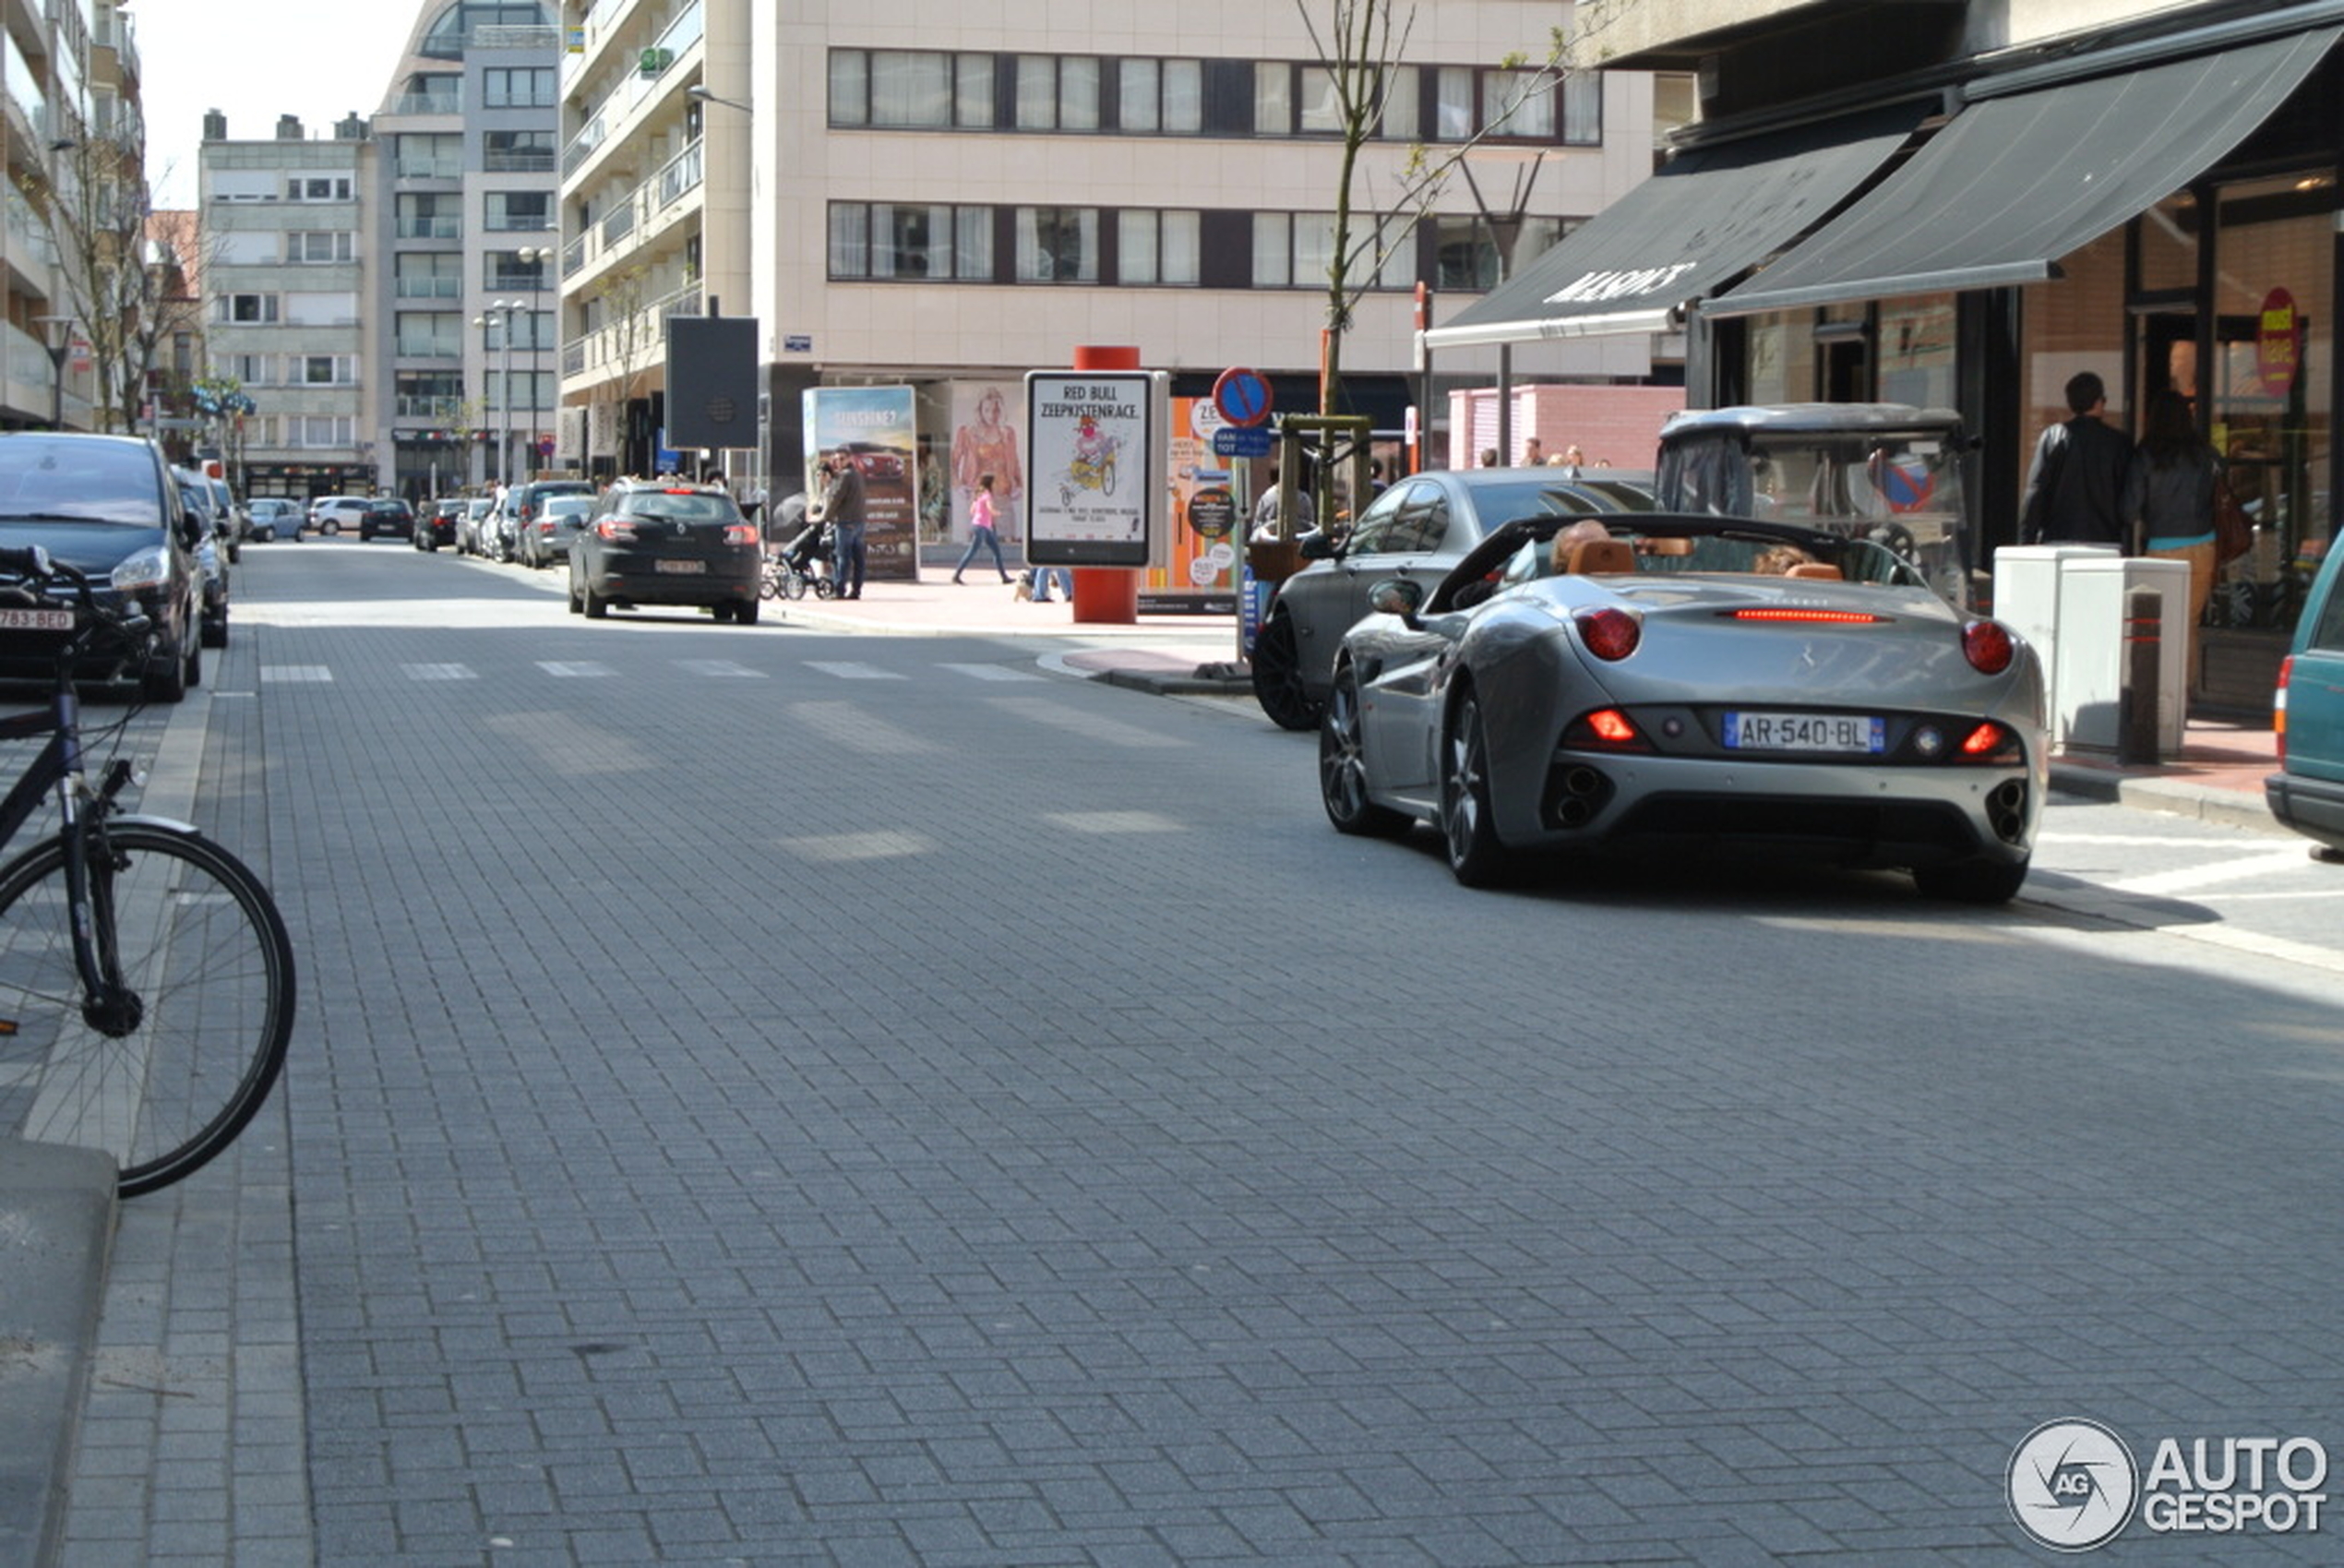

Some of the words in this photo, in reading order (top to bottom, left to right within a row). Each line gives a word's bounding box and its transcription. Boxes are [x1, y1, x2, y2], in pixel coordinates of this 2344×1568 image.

[1063, 386, 1086, 400] RED
[1090, 386, 1118, 401] BULL
[1217, 444, 1237, 453] TOT
[1740, 718, 1867, 748] AR-540-BL
